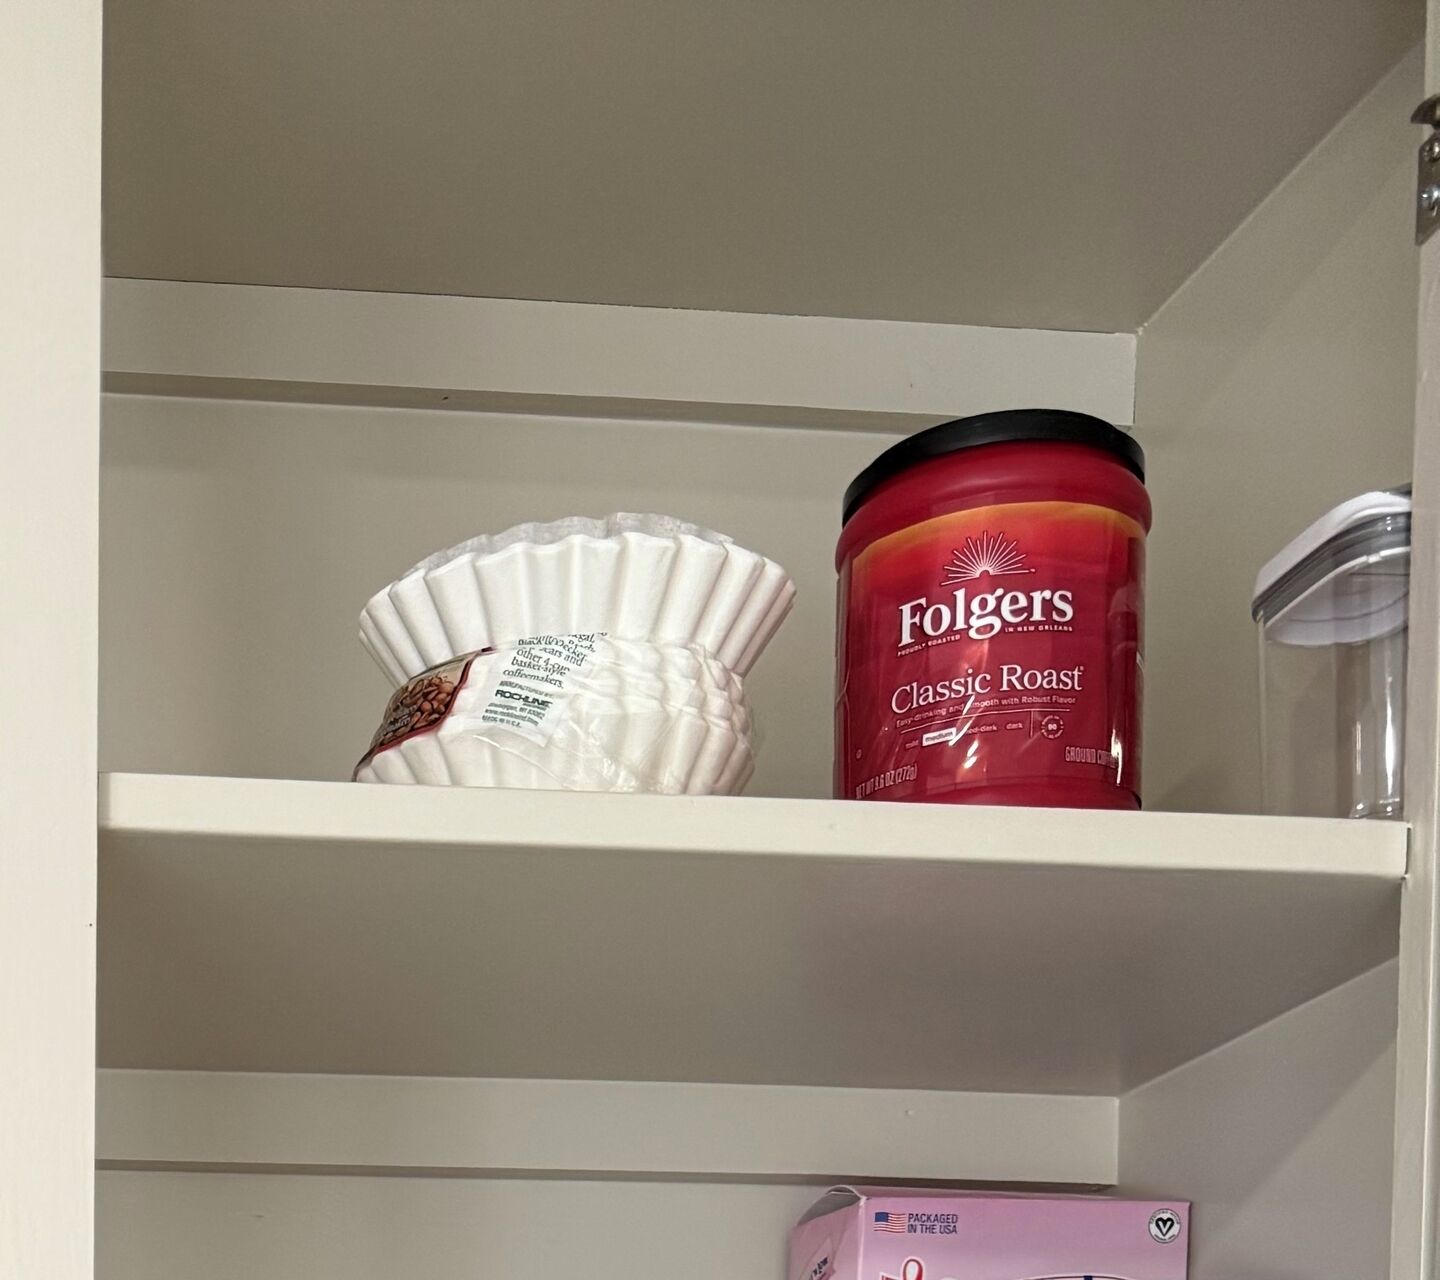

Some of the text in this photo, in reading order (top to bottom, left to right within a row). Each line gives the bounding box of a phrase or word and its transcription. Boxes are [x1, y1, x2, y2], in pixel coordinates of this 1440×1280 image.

[898, 587, 1074, 648] Folgers
[891, 664, 1083, 714] Classic Roast
[964, 698, 999, 708] mooth
[1001, 697, 1019, 705] with
[1021, 695, 1051, 704] Robust
[1052, 695, 1076, 704] Flavor
[907, 1213, 958, 1224] PACKAGED
[907, 1223, 958, 1234] IN THE USA
